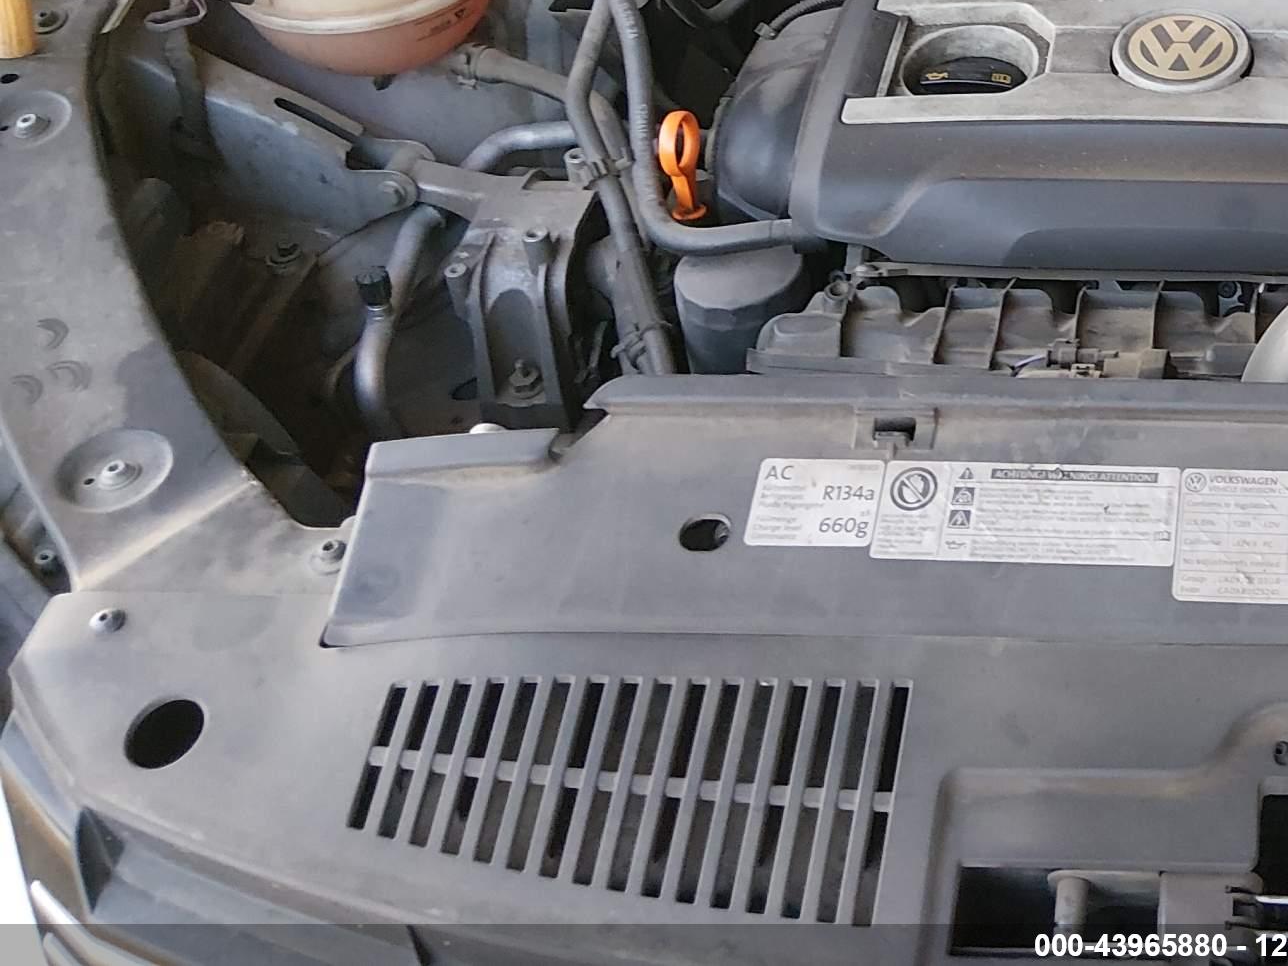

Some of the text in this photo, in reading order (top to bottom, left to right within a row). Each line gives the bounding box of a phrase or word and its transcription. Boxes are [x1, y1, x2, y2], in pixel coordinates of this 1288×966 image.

[1127, 13, 1236, 81] VW
[764, 465, 795, 480] AC
[1209, 475, 1279, 486] VOLKSWAGEN
[822, 485, 876, 501] R134a
[819, 517, 870, 539] 660g
